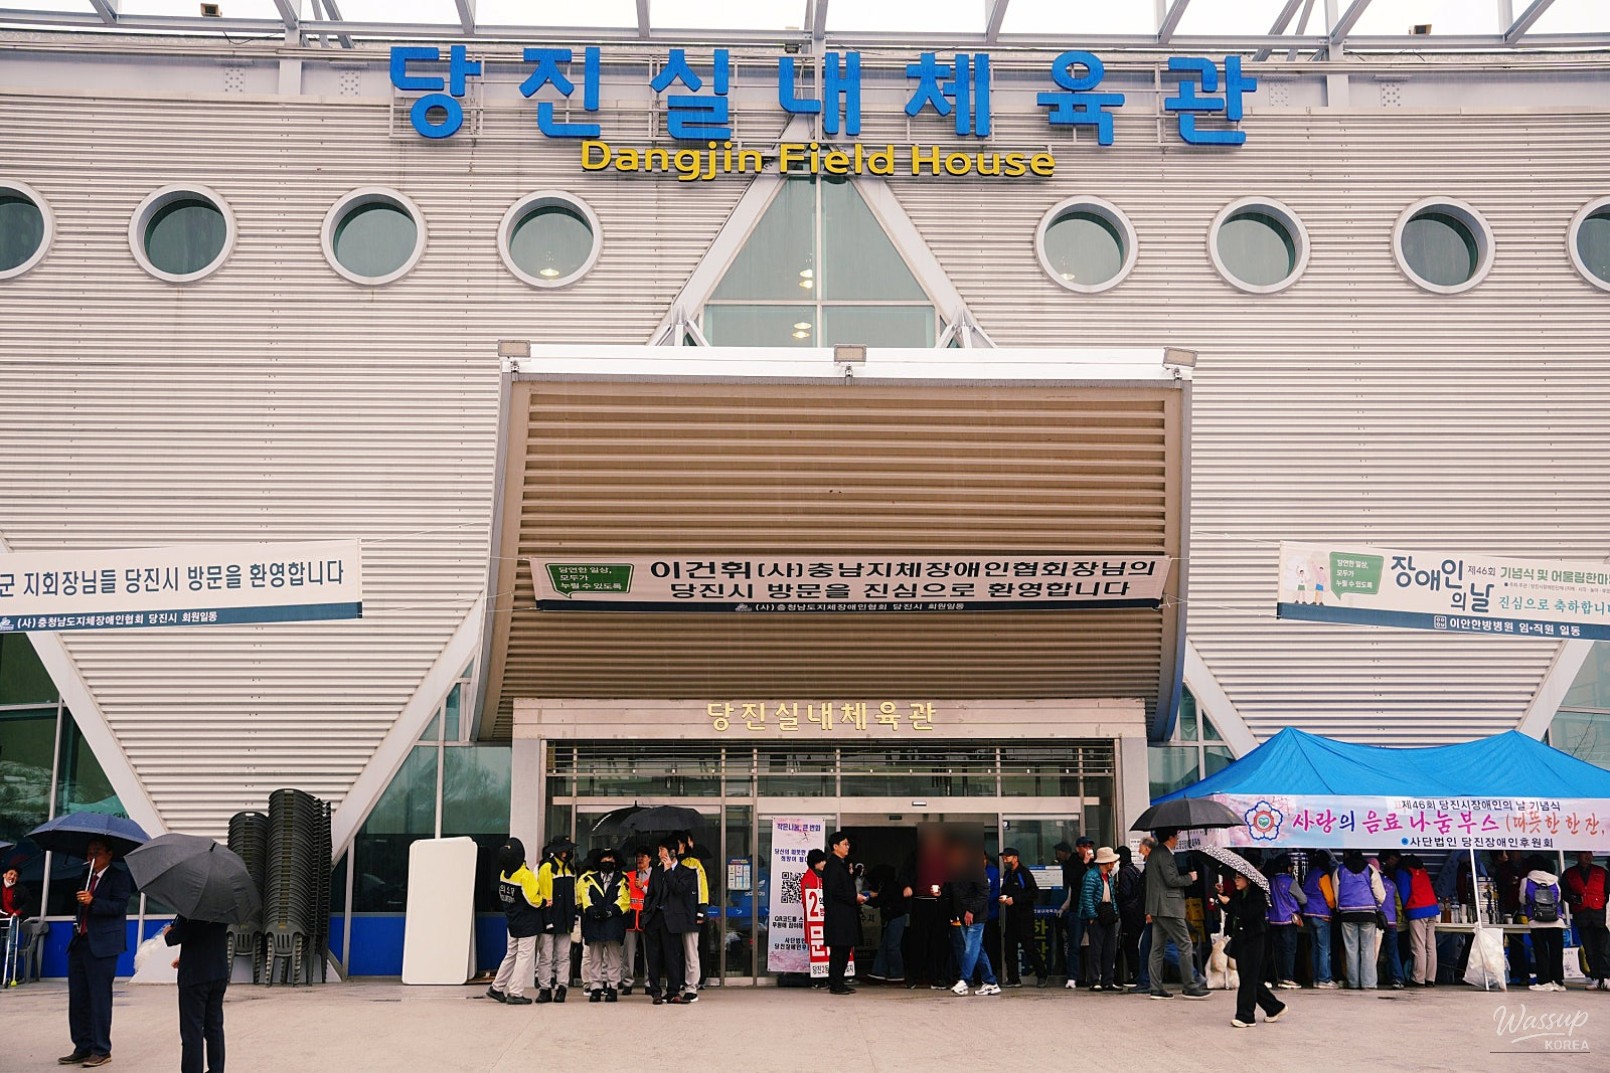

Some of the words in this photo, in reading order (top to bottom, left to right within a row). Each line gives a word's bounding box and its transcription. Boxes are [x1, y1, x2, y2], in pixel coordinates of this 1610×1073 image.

[390, 45, 1257, 146] 당진실내체육관
[580, 140, 763, 181] Dangjin
[778, 142, 896, 176] Field
[911, 145, 1056, 178] House
[23, 568, 117, 597] 지회장님들
[125, 566, 180, 594] 당진시
[187, 564, 242, 591] 방문을
[249, 560, 344, 588] 환영합니다
[1390, 555, 1463, 591] 장애인
[1467, 565, 1496, 577] 제46회
[1500, 566, 1535, 581] 기념식
[1537, 569, 1549, 581] 및
[1551, 569, 1610, 585] 어울림한마
[670, 583, 753, 599] 당진시
[767, 583, 851, 599] 방문을
[863, 582, 975, 599] 진심으로
[987, 581, 1130, 598] 환영합니다
[1498, 595, 1550, 611] 진심으로
[1554, 597, 1610, 616] 축하합니
[17, 614, 144, 629] (사)충청남도지체장애인협회
[148, 612, 178, 625] 당진시
[182, 611, 218, 623] 회원일동
[1450, 618, 1514, 633] 이안한방병원
[1559, 624, 1581, 637] 일동
[706, 701, 937, 732] 당진실내체육관
[1401, 800, 1436, 811] 제46회
[1439, 800, 1513, 812] 당진시장애인의
[1530, 801, 1561, 812] 기념식
[1292, 808, 1356, 834] 사랑의
[1362, 809, 1403, 835] 음료
[1565, 811, 1581, 835] 한
[1410, 836, 1457, 848] 사단법인
[1461, 836, 1554, 848] 당진장애인후원회
